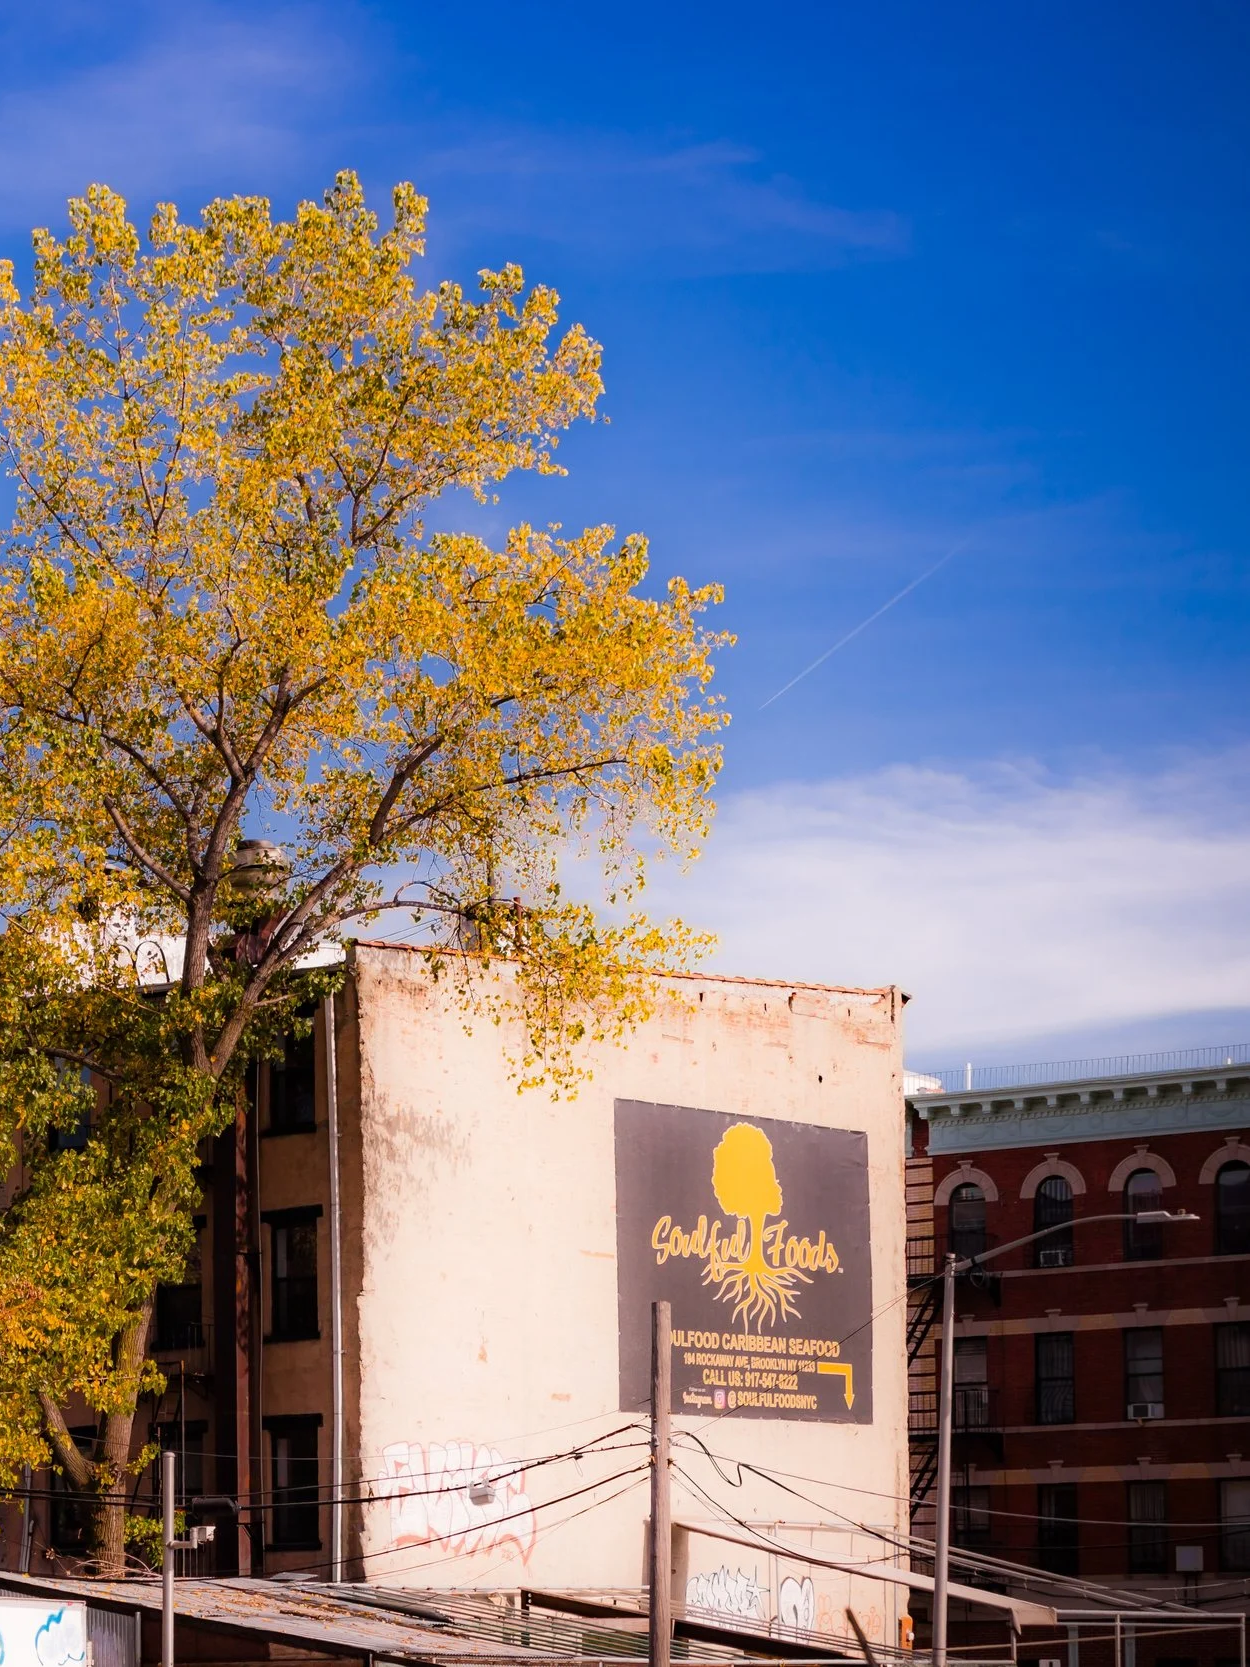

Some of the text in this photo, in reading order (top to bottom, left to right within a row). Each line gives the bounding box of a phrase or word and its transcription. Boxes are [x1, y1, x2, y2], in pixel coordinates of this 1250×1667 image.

[652, 1215, 839, 1282] Soulful Foods
[670, 1329, 840, 1358] ULFOOD CARIBBEAN SEAFOOD
[696, 1352, 735, 1368] ROCKAWAY
[751, 1356, 787, 1371] BROOKLYN
[788, 1359, 797, 1372] NY
[702, 1368, 727, 1386] CALL
